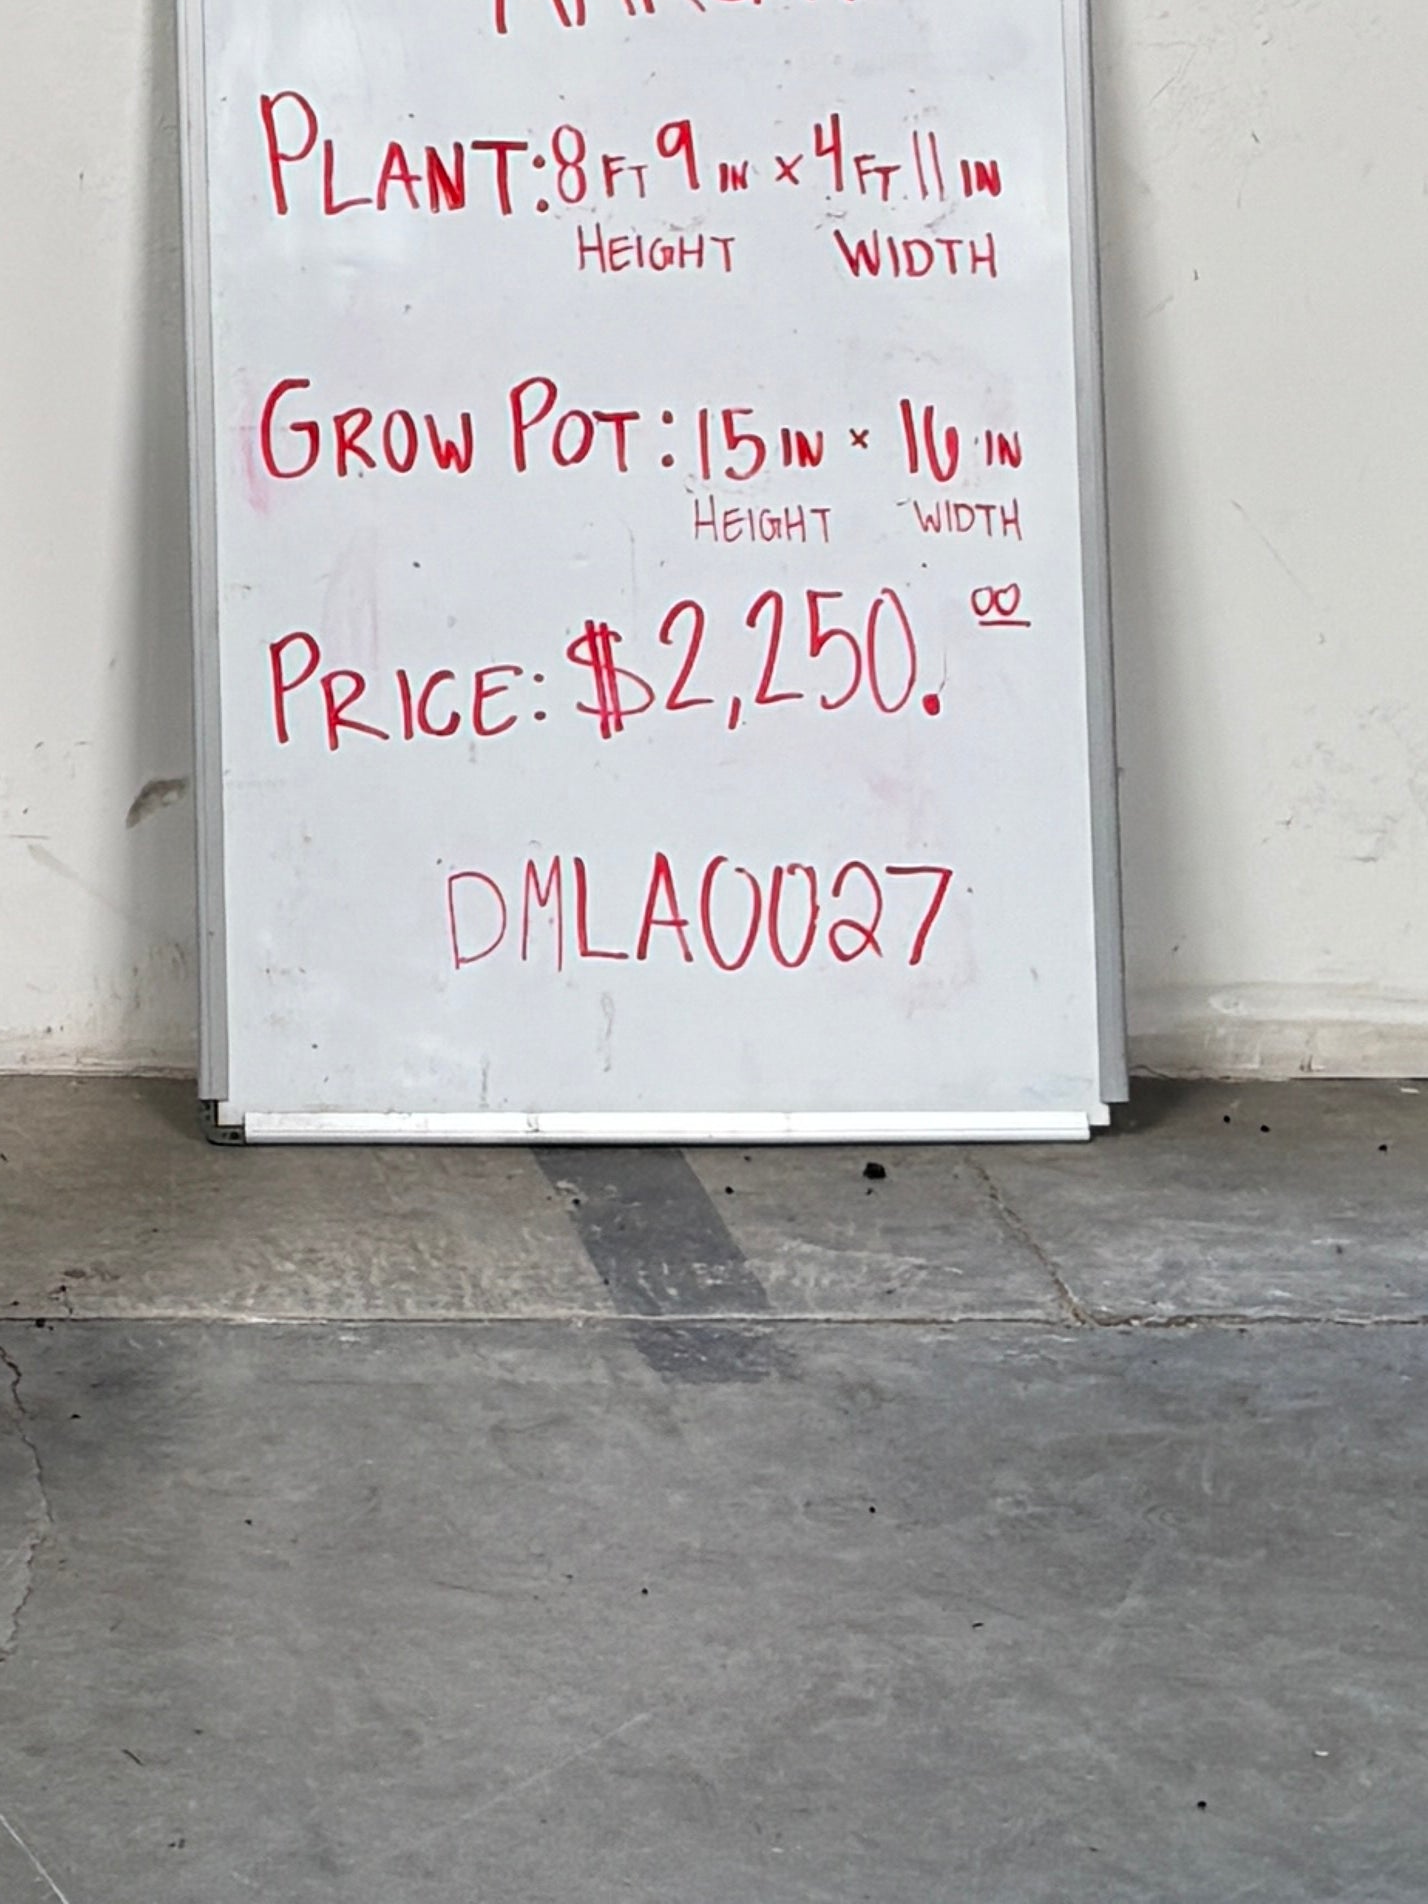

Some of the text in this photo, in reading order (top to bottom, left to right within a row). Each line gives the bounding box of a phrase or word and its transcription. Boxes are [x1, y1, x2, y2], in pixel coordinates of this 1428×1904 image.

[258, 92, 548, 216] PLANT:
[576, 226, 999, 280] HEIGHT WIDTH
[258, 378, 475, 480] GROW
[507, 376, 676, 473] POT:
[693, 497, 1024, 542] HEIGHT WIDTH
[268, 632, 549, 752] PRICE:
[446, 852, 955, 972] DMLA0027
